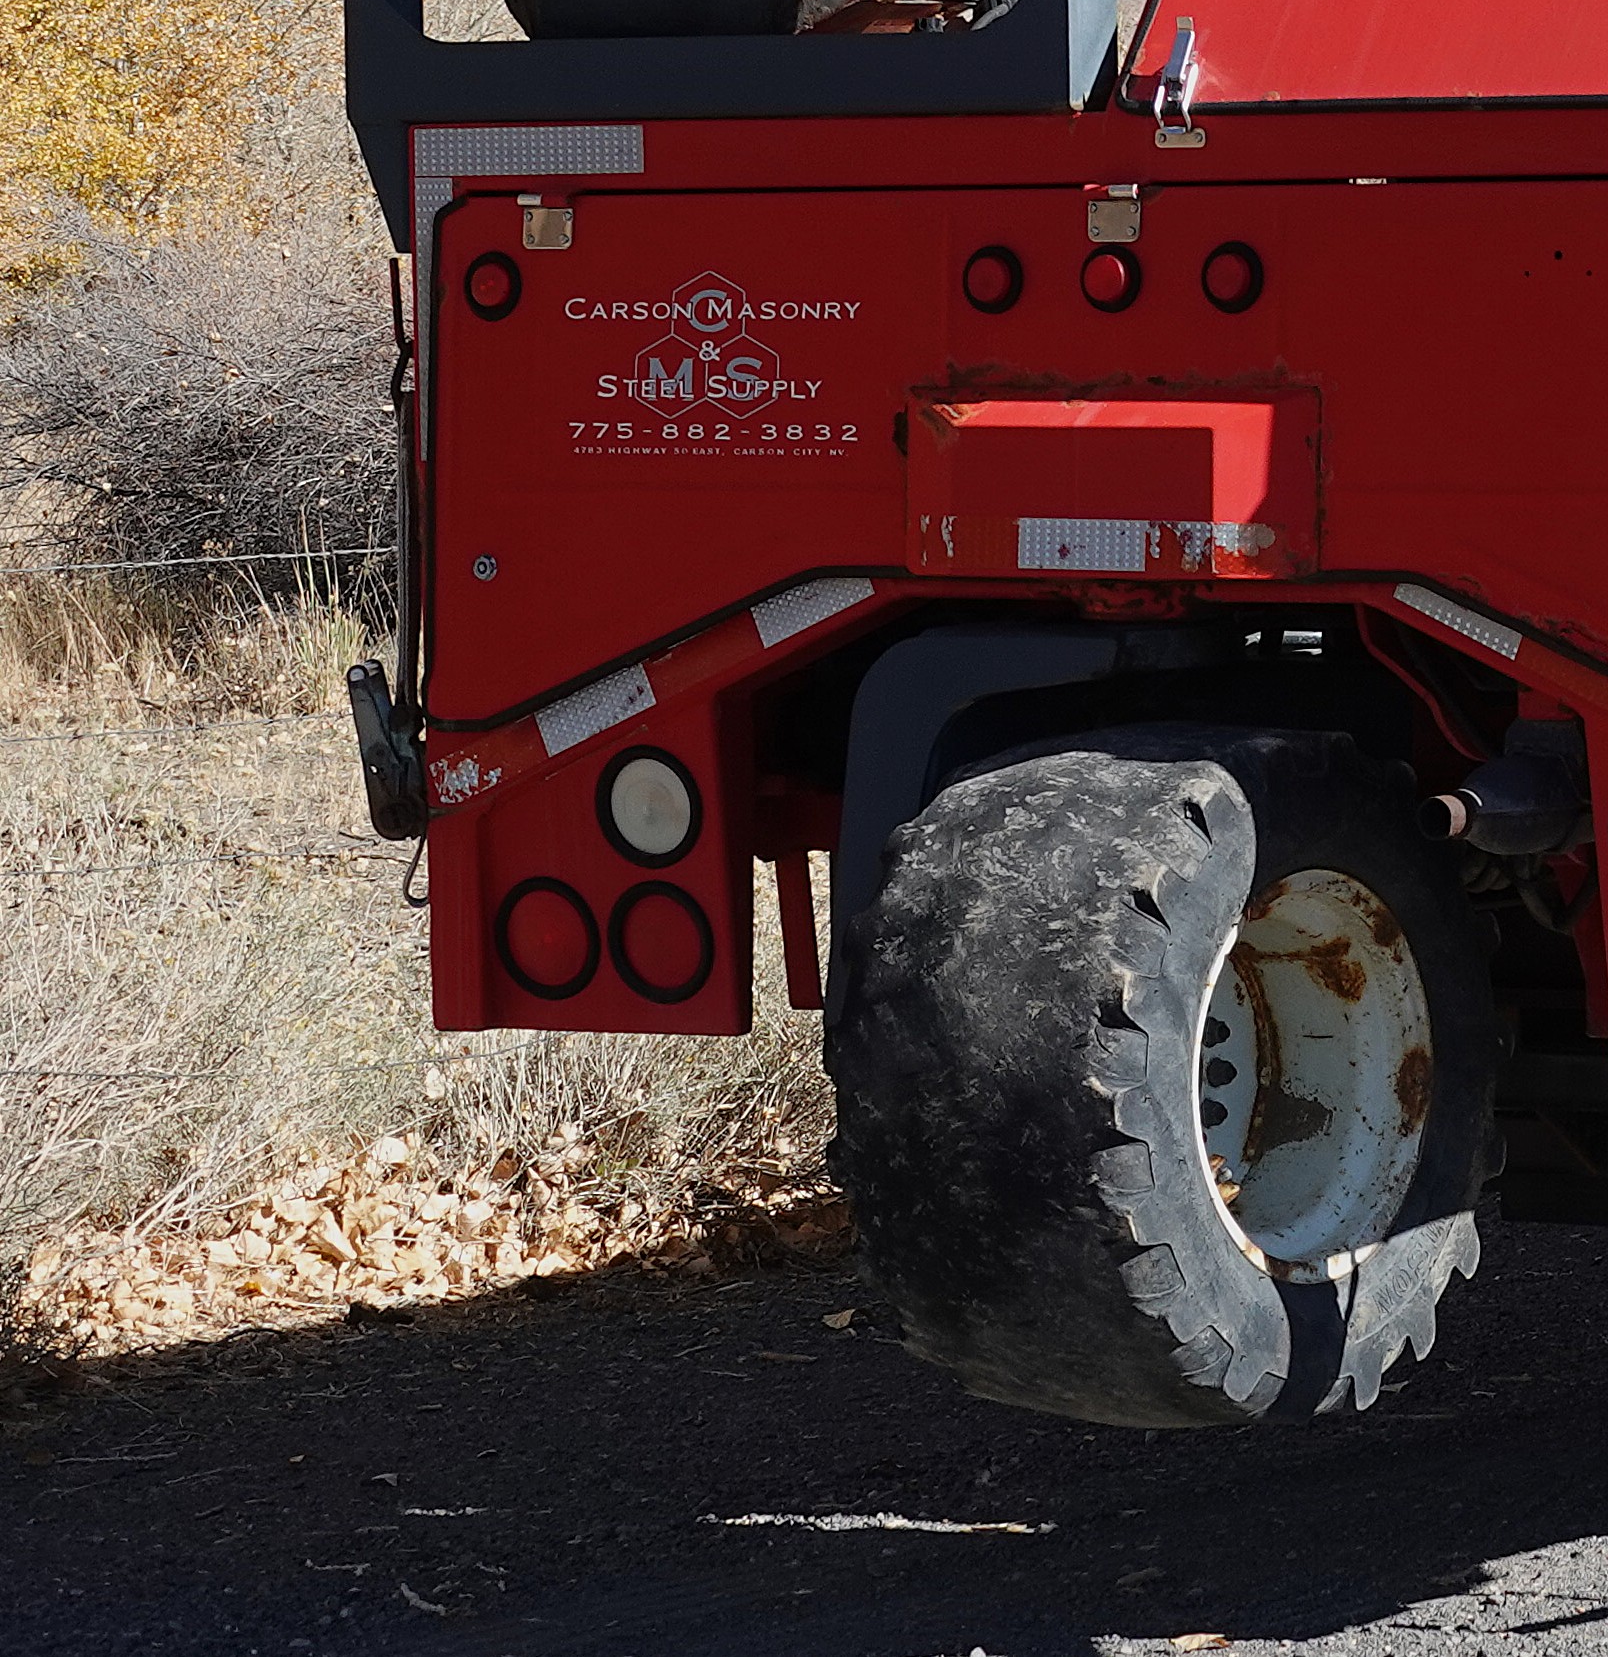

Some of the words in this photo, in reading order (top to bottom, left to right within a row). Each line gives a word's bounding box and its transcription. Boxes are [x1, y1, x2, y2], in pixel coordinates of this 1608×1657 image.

[564, 297, 692, 320] CARSON
[708, 298, 861, 320] MASONRY
[699, 340, 720, 362] &
[597, 374, 694, 399] STEEL
[707, 375, 822, 399] SUPPLY
[568, 422, 859, 442] 775-882-3832
[607, 447, 667, 455] HIGHWAY
[733, 447, 785, 456] CARSON
[793, 448, 821, 456] CITY
